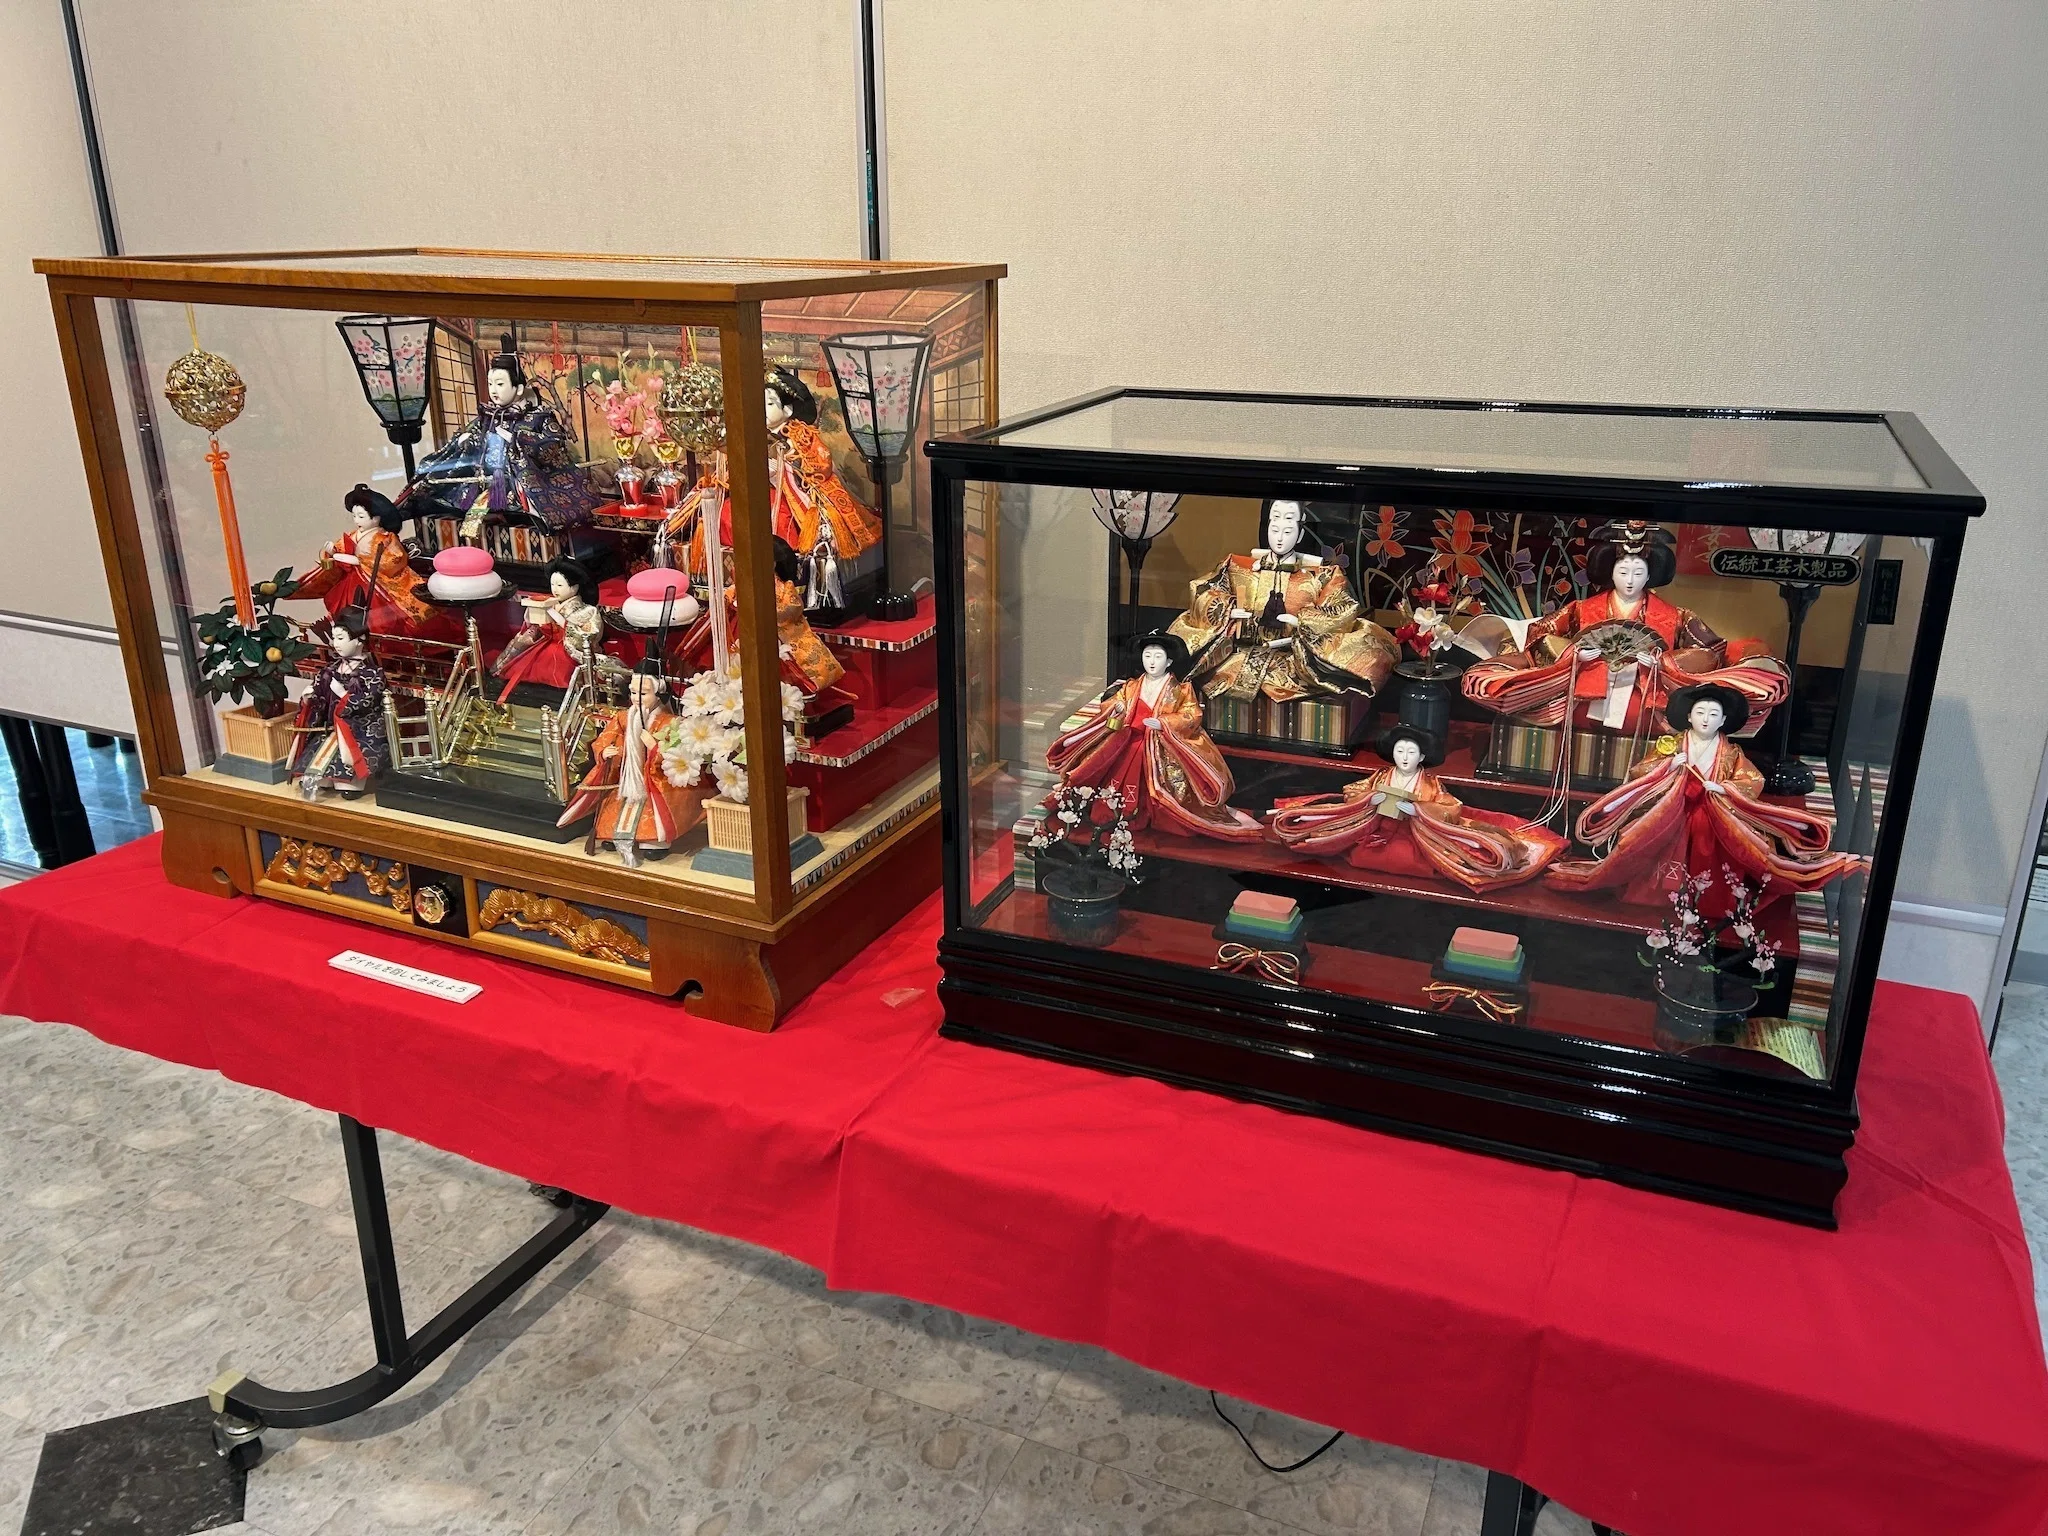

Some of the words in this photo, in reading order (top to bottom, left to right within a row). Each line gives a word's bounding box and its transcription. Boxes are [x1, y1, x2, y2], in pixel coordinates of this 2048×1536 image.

[1720, 554, 1848, 579] 伝統工芸木製品
[344, 955, 467, 993] ダイヤルを回してみましょう
